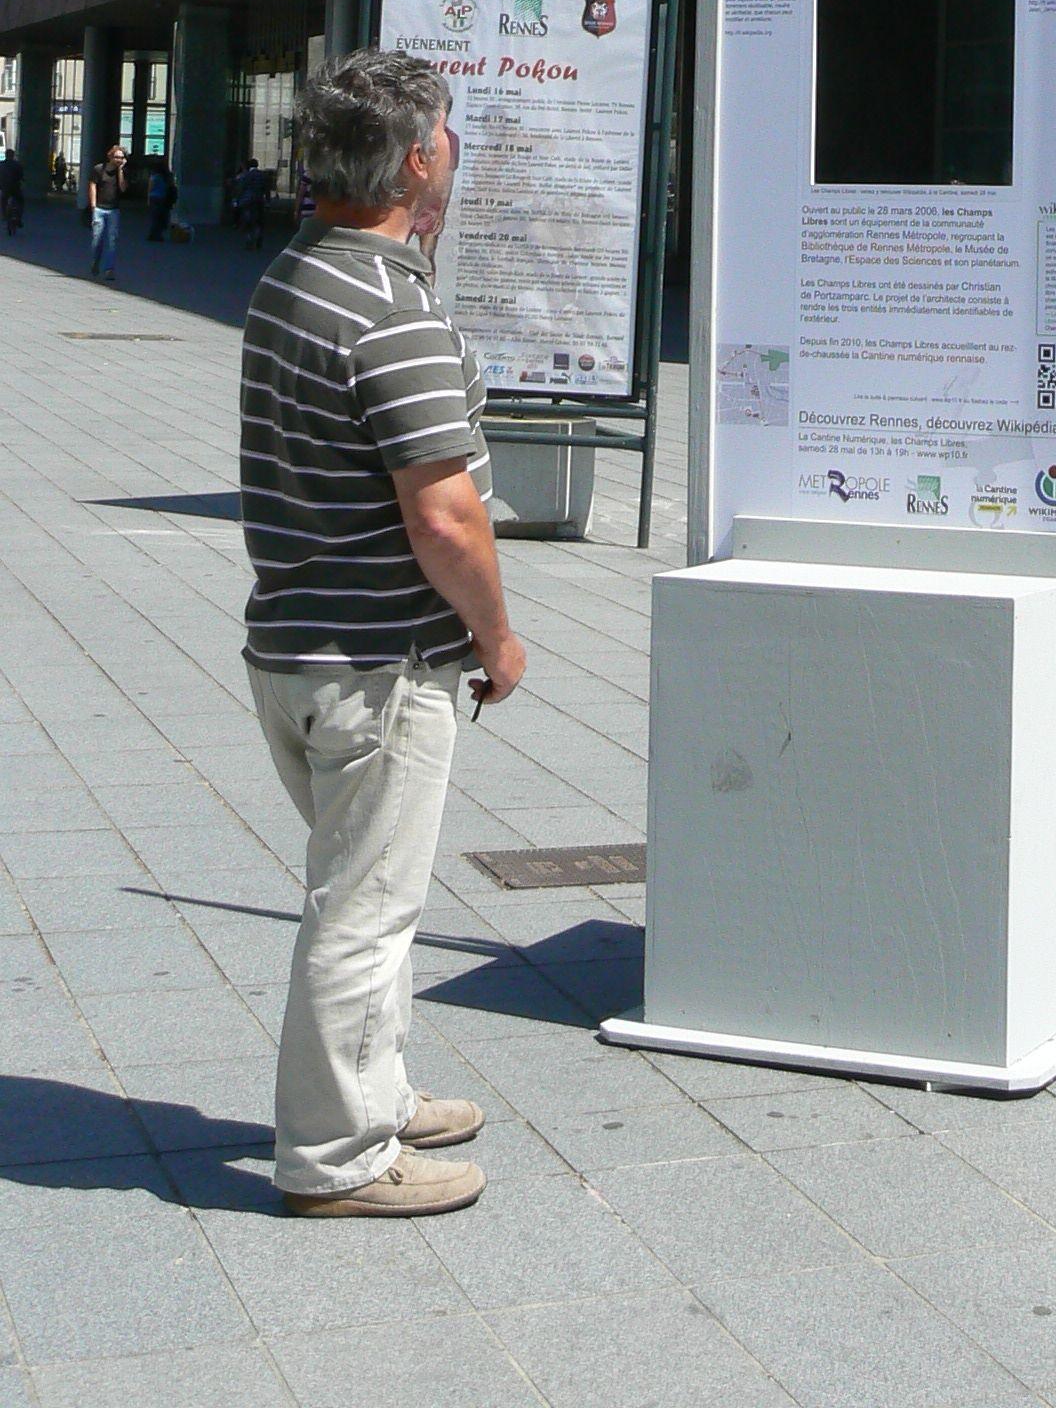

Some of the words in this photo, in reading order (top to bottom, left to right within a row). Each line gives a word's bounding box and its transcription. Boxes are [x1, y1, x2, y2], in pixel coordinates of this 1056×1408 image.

[396, 36, 471, 52] ÉVÉNEMENT
[498, 57, 578, 84] Pokou
[468, 85, 490, 95] Lundi
[494, 86, 503, 96] 16
[505, 86, 521, 96] mai
[466, 113, 490, 123] Mardi
[494, 114, 503, 123] 17
[504, 114, 520, 124] mai
[464, 141, 501, 152] Mercredi
[505, 143, 513, 152] 18
[516, 143, 532, 153] mai
[460, 196, 482, 206] Jeudi
[485, 197, 494, 206] 19
[496, 197, 512, 207] mai
[459, 230, 496, 241] Vendredi
[499, 231, 508, 241] 20
[511, 232, 526, 242] mai
[456, 292, 485, 303] Samedi
[488, 294, 497, 303] 21
[500, 294, 516, 304] mai
[800, 410, 865, 426] Découvrez
[869, 413, 921, 430] Rennes,
[926, 415, 995, 431] découvrez
